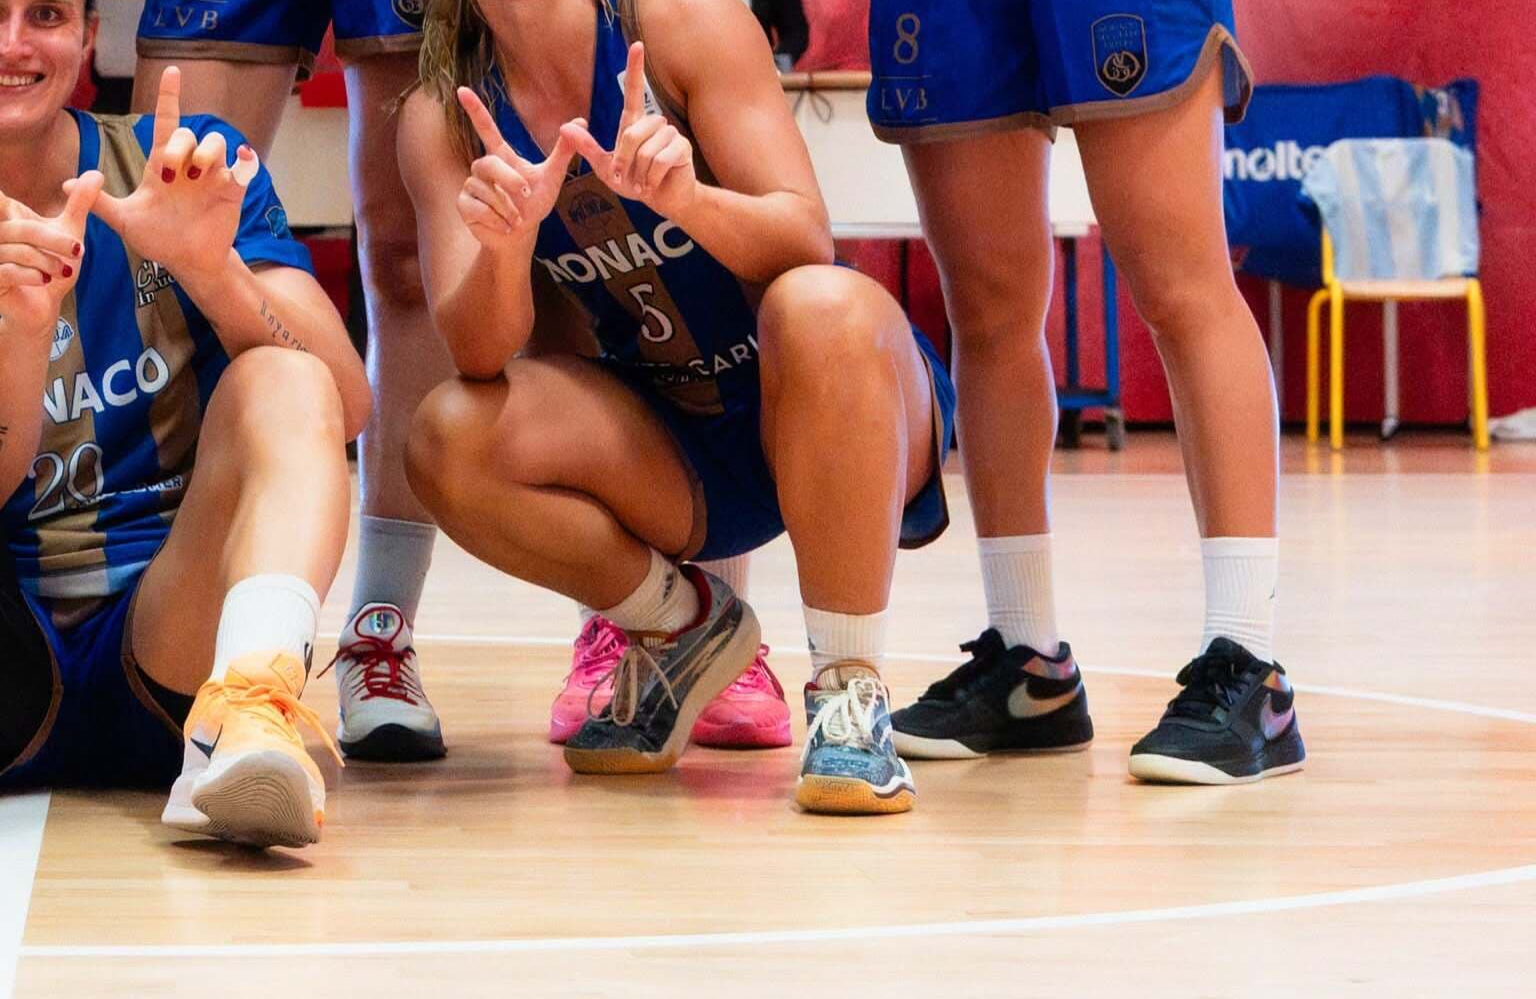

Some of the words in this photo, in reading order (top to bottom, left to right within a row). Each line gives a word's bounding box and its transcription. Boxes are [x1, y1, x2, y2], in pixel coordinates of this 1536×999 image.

[153, 5, 218, 30] LVB
[892, 13, 921, 64] 8
[880, 85, 929, 111] LVB
[628, 283, 673, 343] 5
[43, 345, 170, 425] NACO
[27, 442, 105, 521] 20
